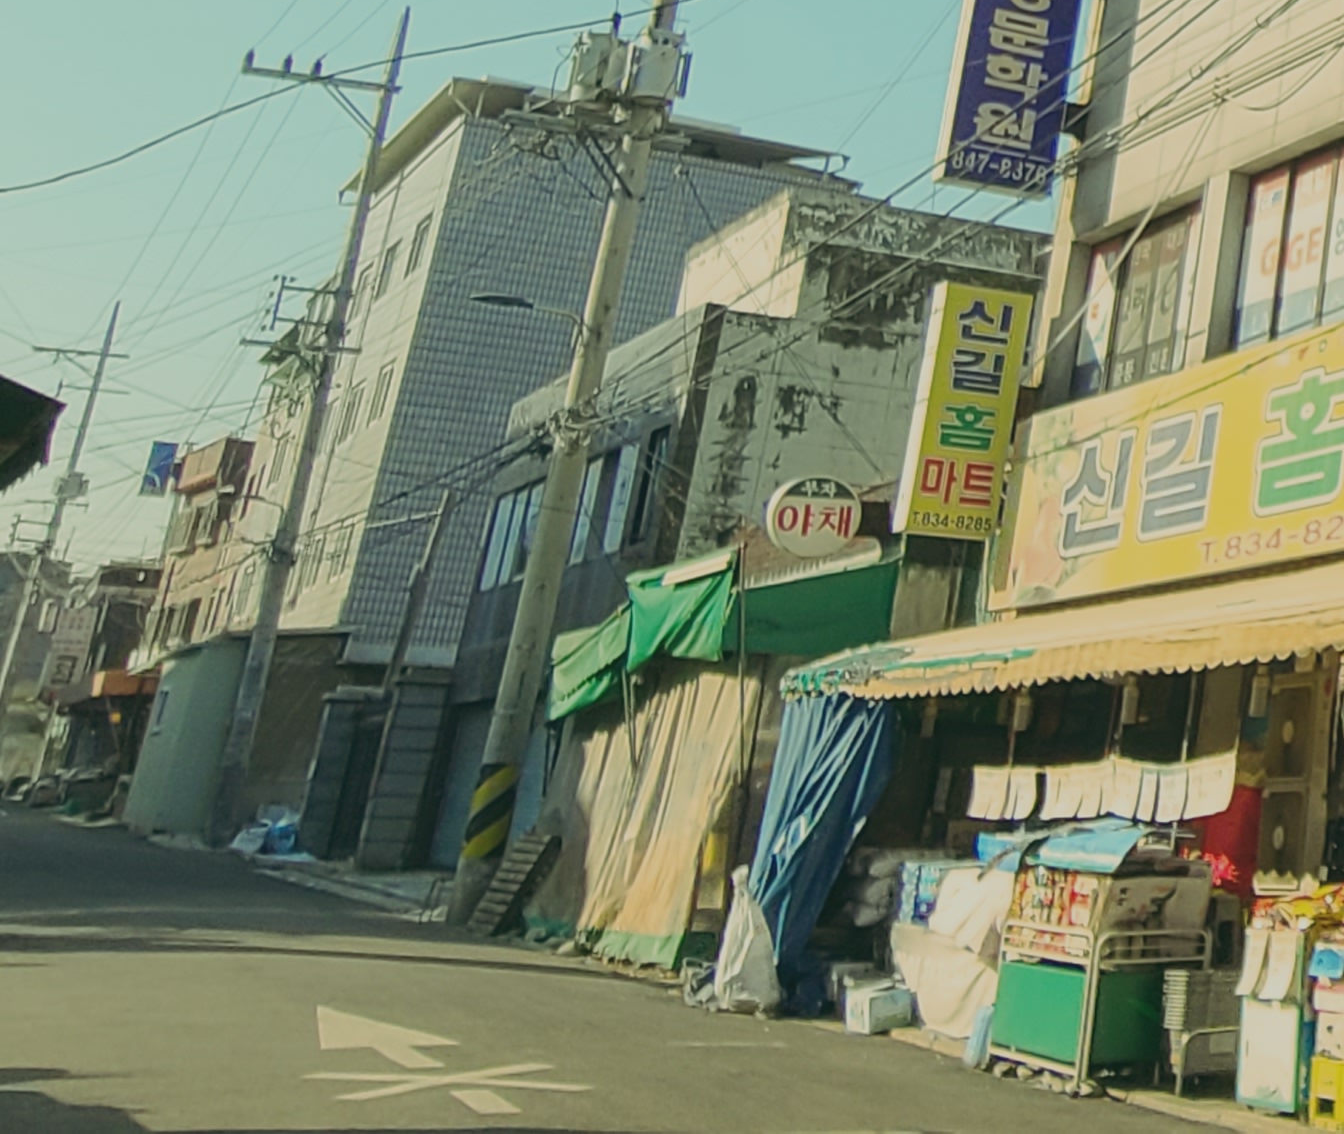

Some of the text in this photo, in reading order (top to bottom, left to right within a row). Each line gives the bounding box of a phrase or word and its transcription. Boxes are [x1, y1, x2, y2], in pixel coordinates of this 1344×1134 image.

[951, 299, 1015, 397] 신길
[937, 402, 997, 453] 홈
[919, 457, 996, 508] 마트
[1056, 402, 1225, 561] 신길
[777, 503, 853, 539] 야채
[912, 510, 993, 533] T.834-8285
